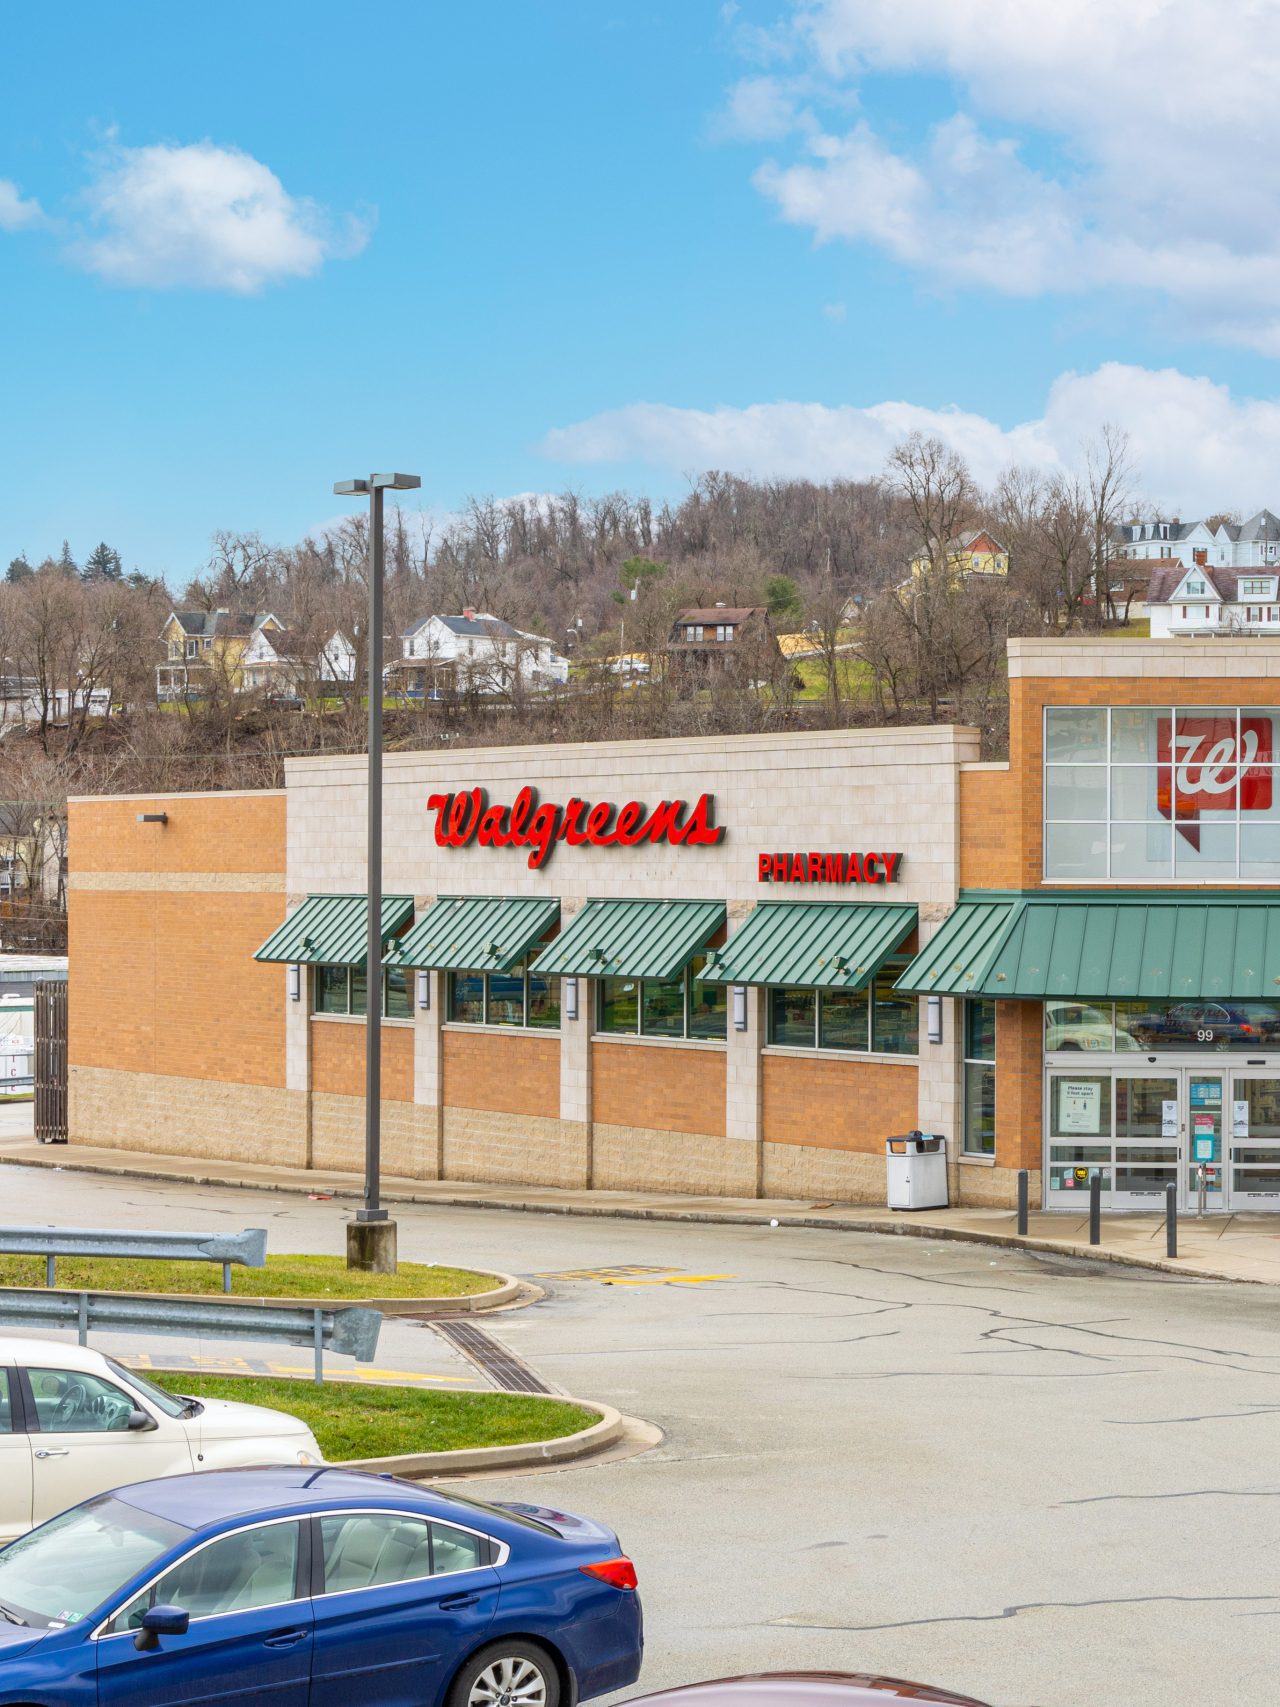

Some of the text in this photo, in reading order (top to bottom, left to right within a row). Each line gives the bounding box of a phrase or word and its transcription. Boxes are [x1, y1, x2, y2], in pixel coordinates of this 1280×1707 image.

[427, 786, 725, 870] Walgreens
[759, 853, 900, 884] PHARMACY
[1197, 1029, 1214, 1042] 99
